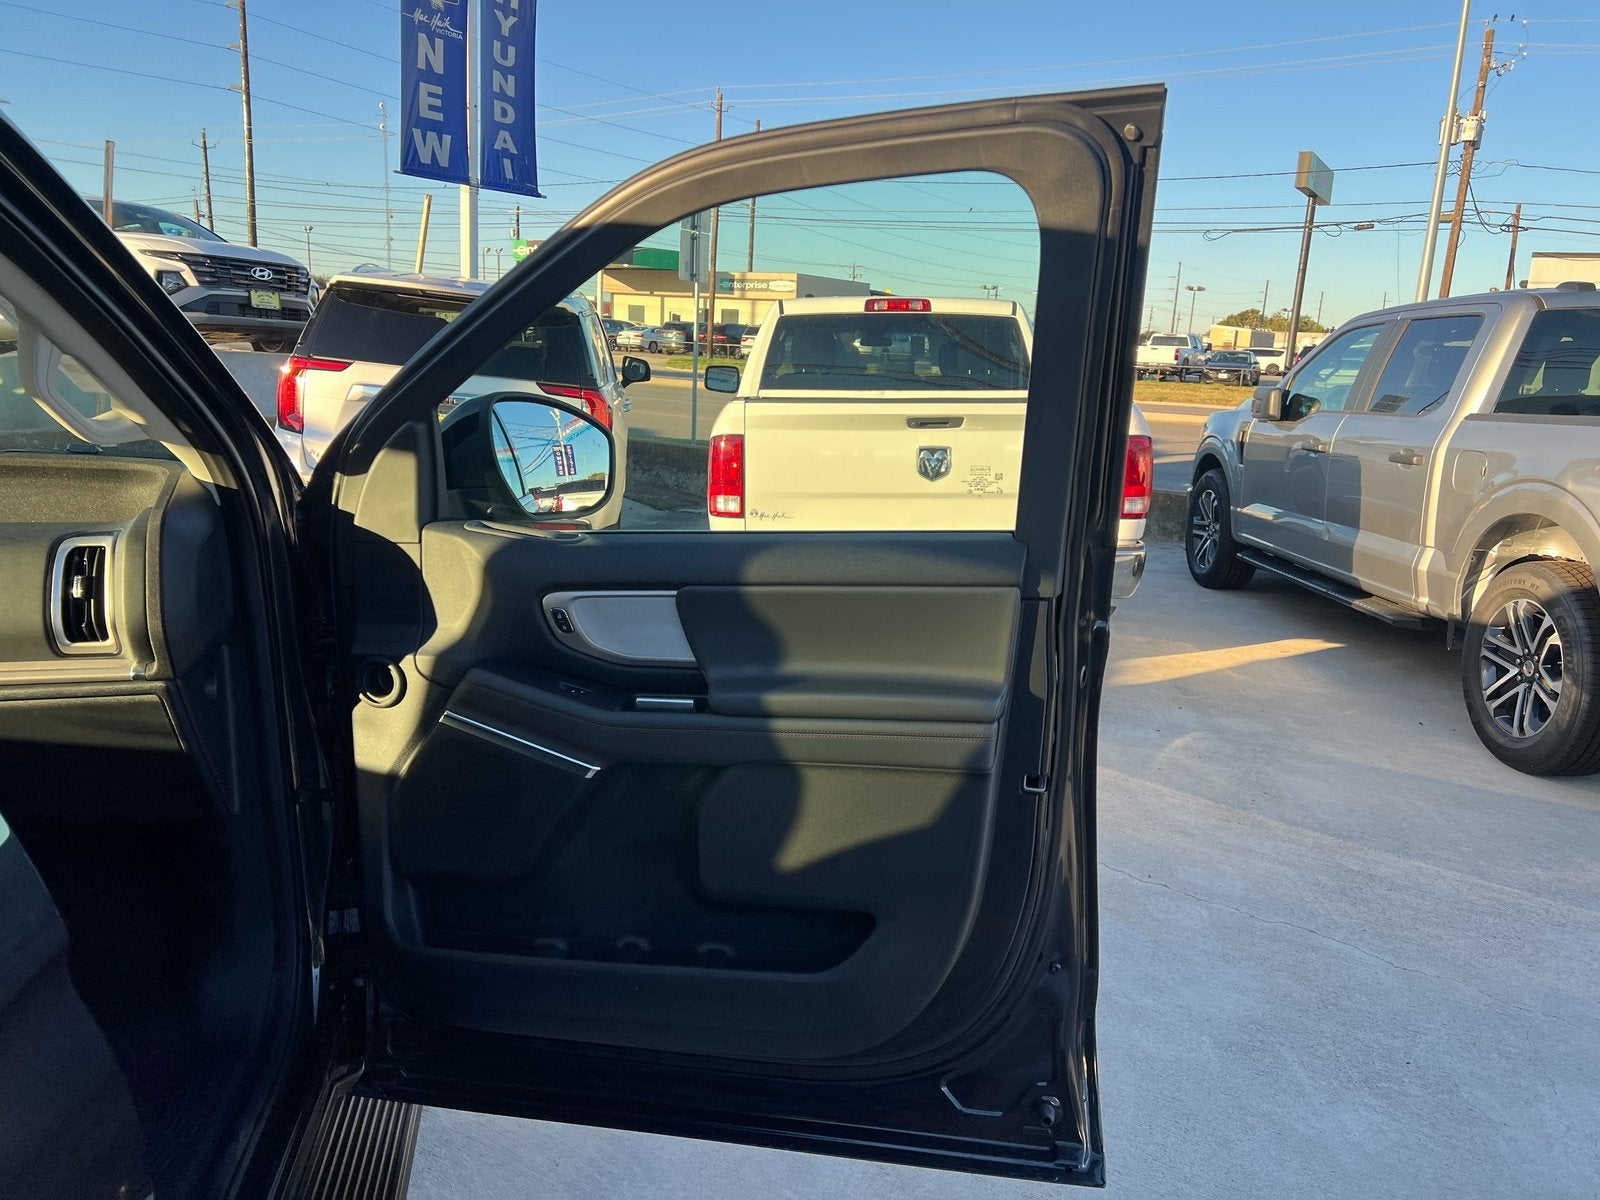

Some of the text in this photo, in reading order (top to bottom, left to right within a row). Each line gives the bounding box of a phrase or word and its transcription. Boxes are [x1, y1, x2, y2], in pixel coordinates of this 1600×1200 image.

[435, 27, 463, 40] VICTORIA
[412, 32, 452, 168] NEW
[720, 280, 768, 290] enterprise
